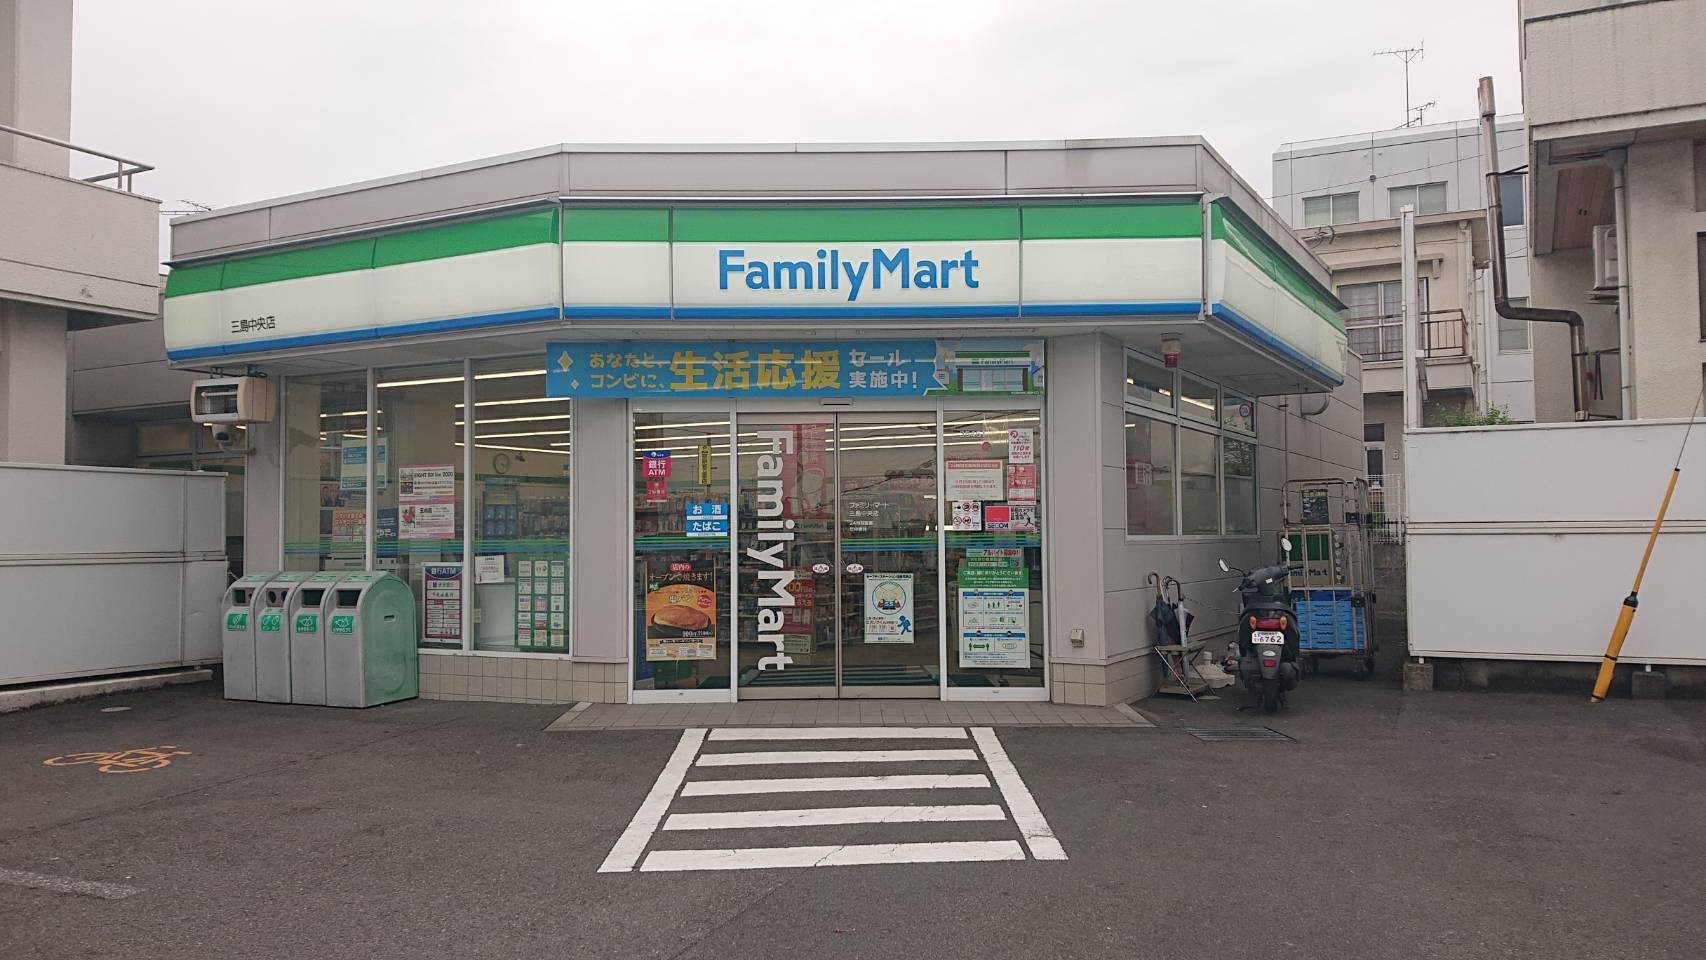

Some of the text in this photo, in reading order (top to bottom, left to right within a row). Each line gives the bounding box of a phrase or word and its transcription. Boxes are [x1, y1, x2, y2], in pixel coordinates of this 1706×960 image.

[719, 248, 979, 302] FamilyMart
[231, 315, 276, 334] 三島中央店
[588, 352, 665, 369] あなたと、
[848, 351, 906, 369] セール
[669, 350, 842, 391] 生活応援
[848, 370, 918, 390] 実施中!
[591, 372, 666, 391] コンビに、
[648, 460, 666, 469] 銀行
[692, 521, 721, 531] たばこ
[747, 430, 795, 671] FamilyMart
[431, 567, 456, 575] 銀行ATM
